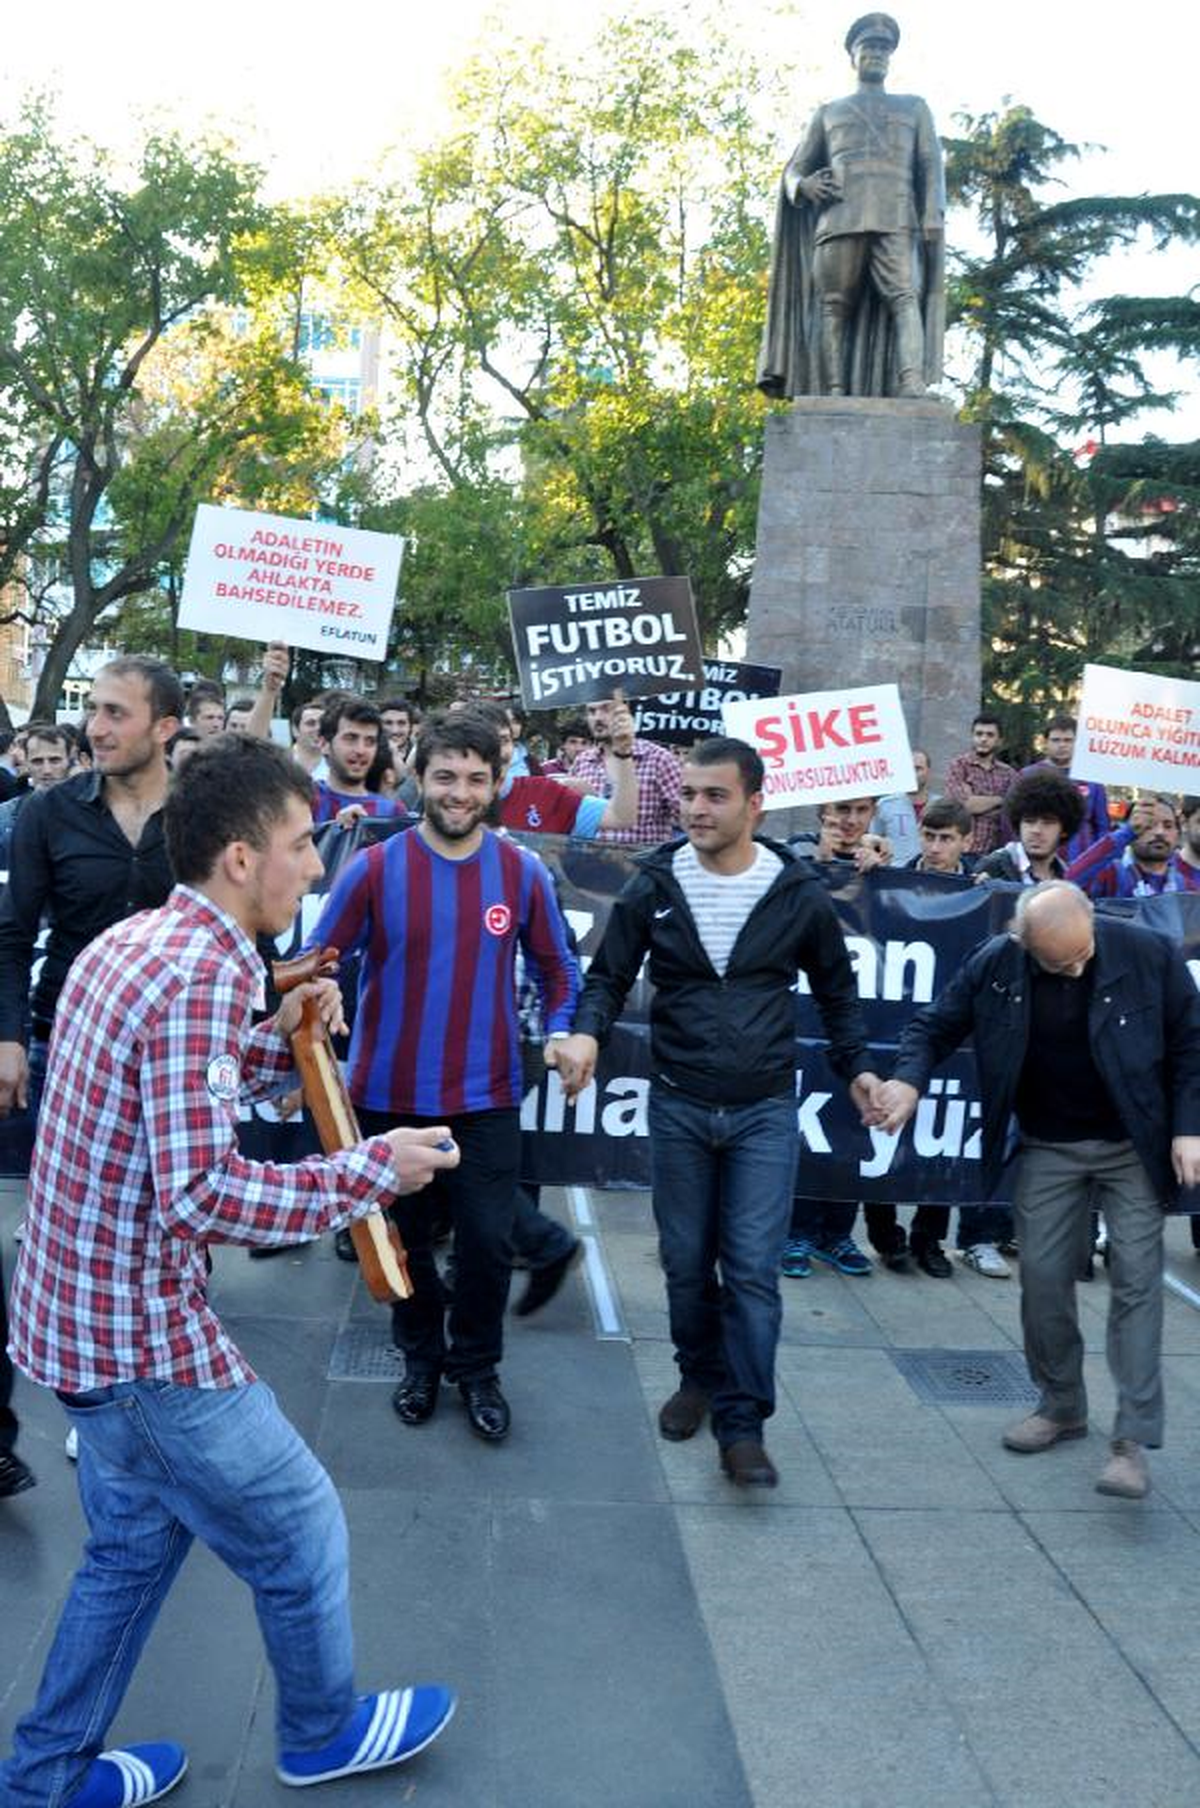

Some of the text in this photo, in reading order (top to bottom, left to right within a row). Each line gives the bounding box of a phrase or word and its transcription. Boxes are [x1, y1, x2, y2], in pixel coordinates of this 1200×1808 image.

[247, 568, 333, 594] AHLAKTA
[315, 559, 376, 581] YERDE
[564, 585, 642, 613] TEMİZ
[320, 625, 377, 644] EFLATUN
[526, 613, 687, 656] FUTBOL
[530, 654, 695, 700] İSTİYORUZ.
[703, 664, 738, 683] MİZ
[633, 705, 726, 736] İSTİYOR
[1131, 702, 1193, 725] ADALET
[755, 702, 882, 768] ŞİKE
[1086, 717, 1152, 739] OLUNCA
[1089, 736, 1146, 759] LÜZUM
